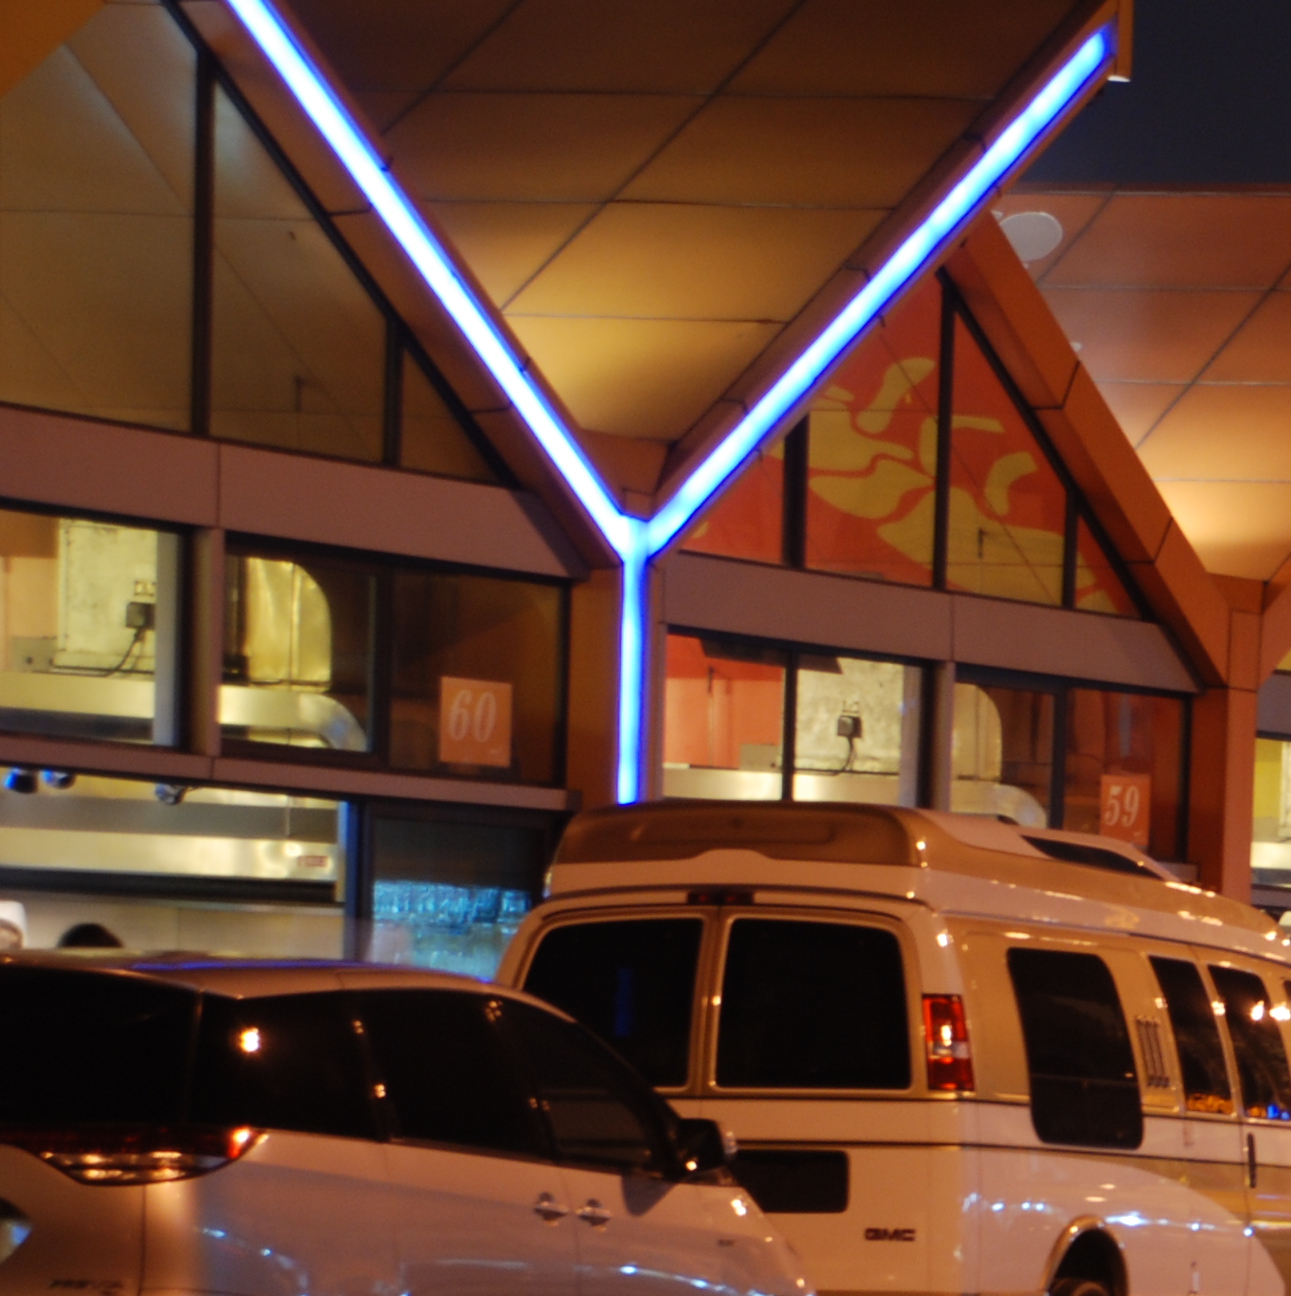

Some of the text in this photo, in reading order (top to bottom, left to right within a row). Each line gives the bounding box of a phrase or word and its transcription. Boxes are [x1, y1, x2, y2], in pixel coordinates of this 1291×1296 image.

[448, 689, 498, 743] 60
[1104, 785, 1141, 828] 59
[864, 1228, 916, 1241] GMC
